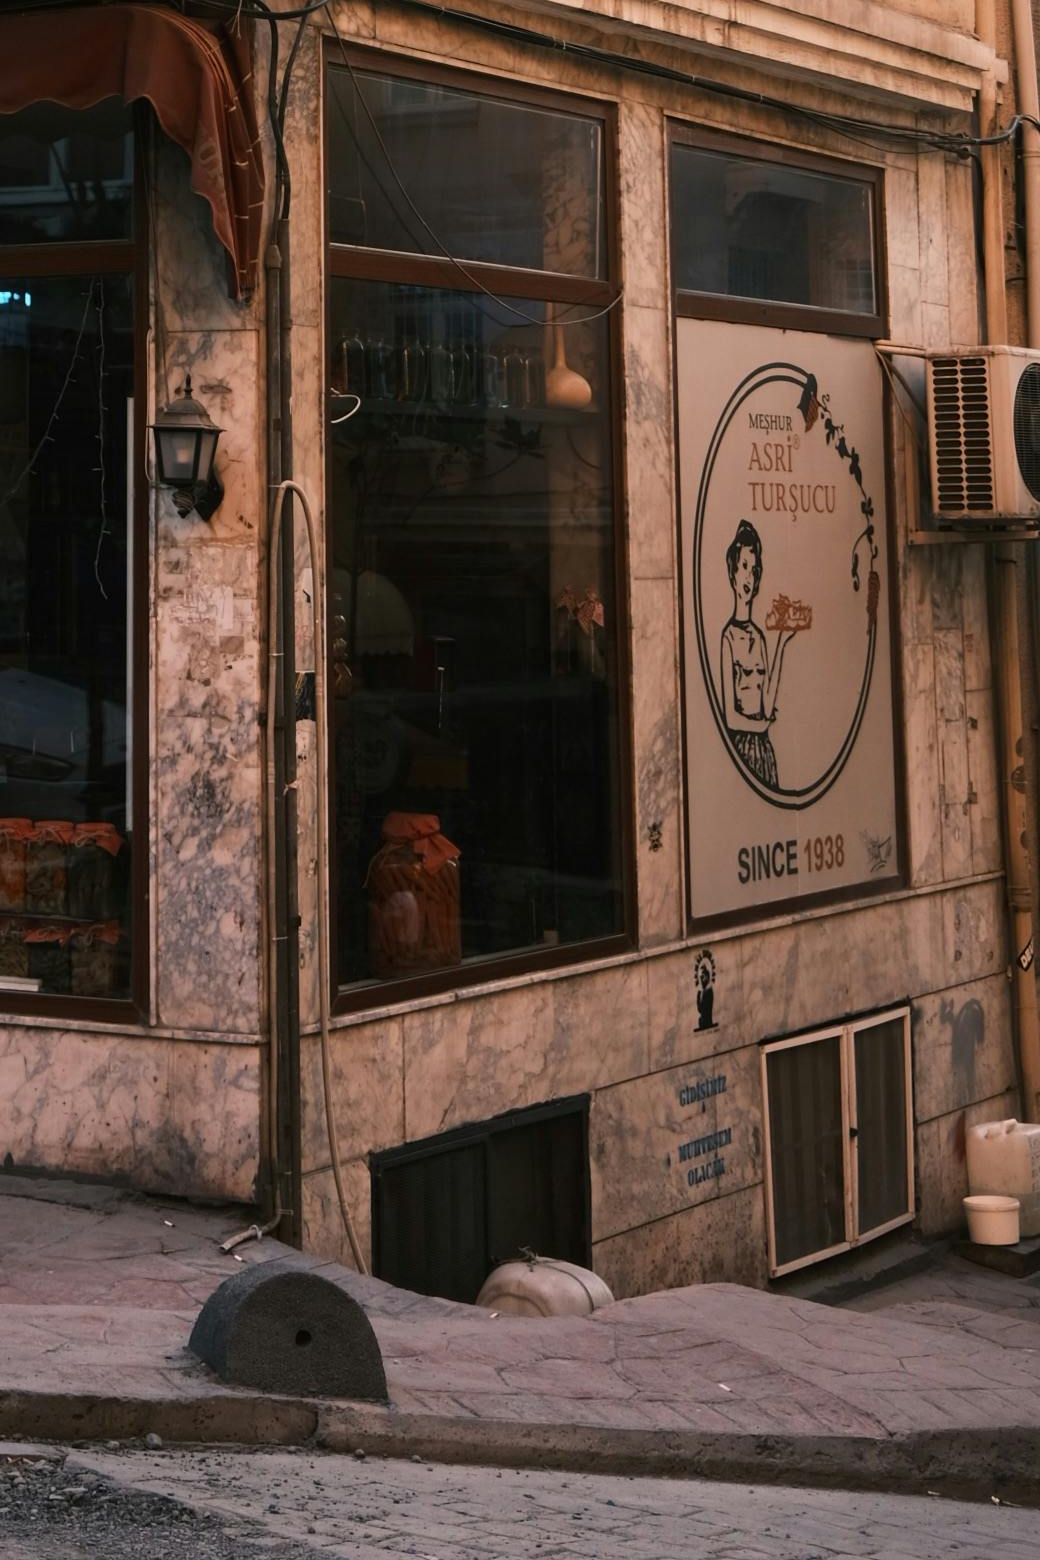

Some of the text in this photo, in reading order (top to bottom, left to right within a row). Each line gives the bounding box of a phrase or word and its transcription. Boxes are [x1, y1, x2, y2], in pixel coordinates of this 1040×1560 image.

[748, 413, 793, 435] MEŞHUR
[747, 482, 836, 522] TURŞUCU
[737, 840, 799, 885] SINCE
[804, 834, 845, 873] 1938
